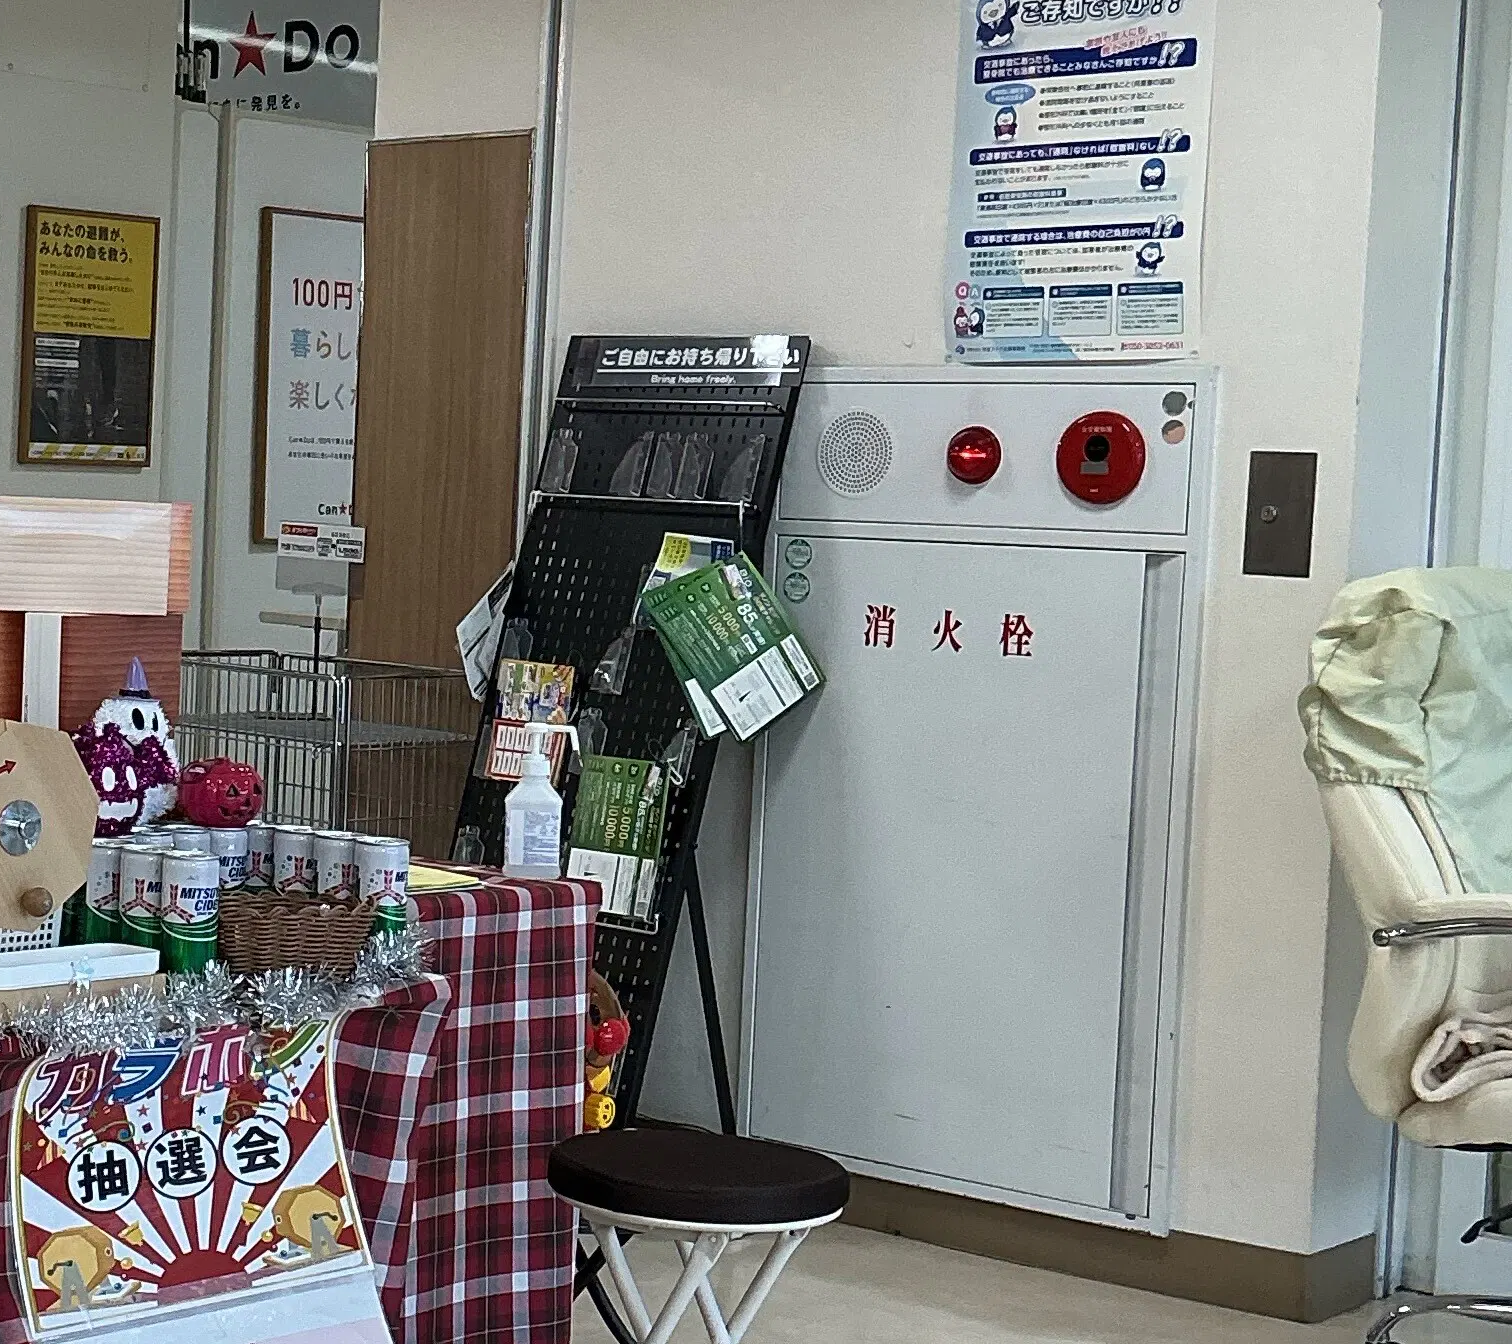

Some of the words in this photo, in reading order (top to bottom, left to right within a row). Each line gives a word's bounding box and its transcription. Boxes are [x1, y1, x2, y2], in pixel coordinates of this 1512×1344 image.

[864, 605, 1034, 657] 消火栓
[76, 1125, 282, 1205] 抽選会
